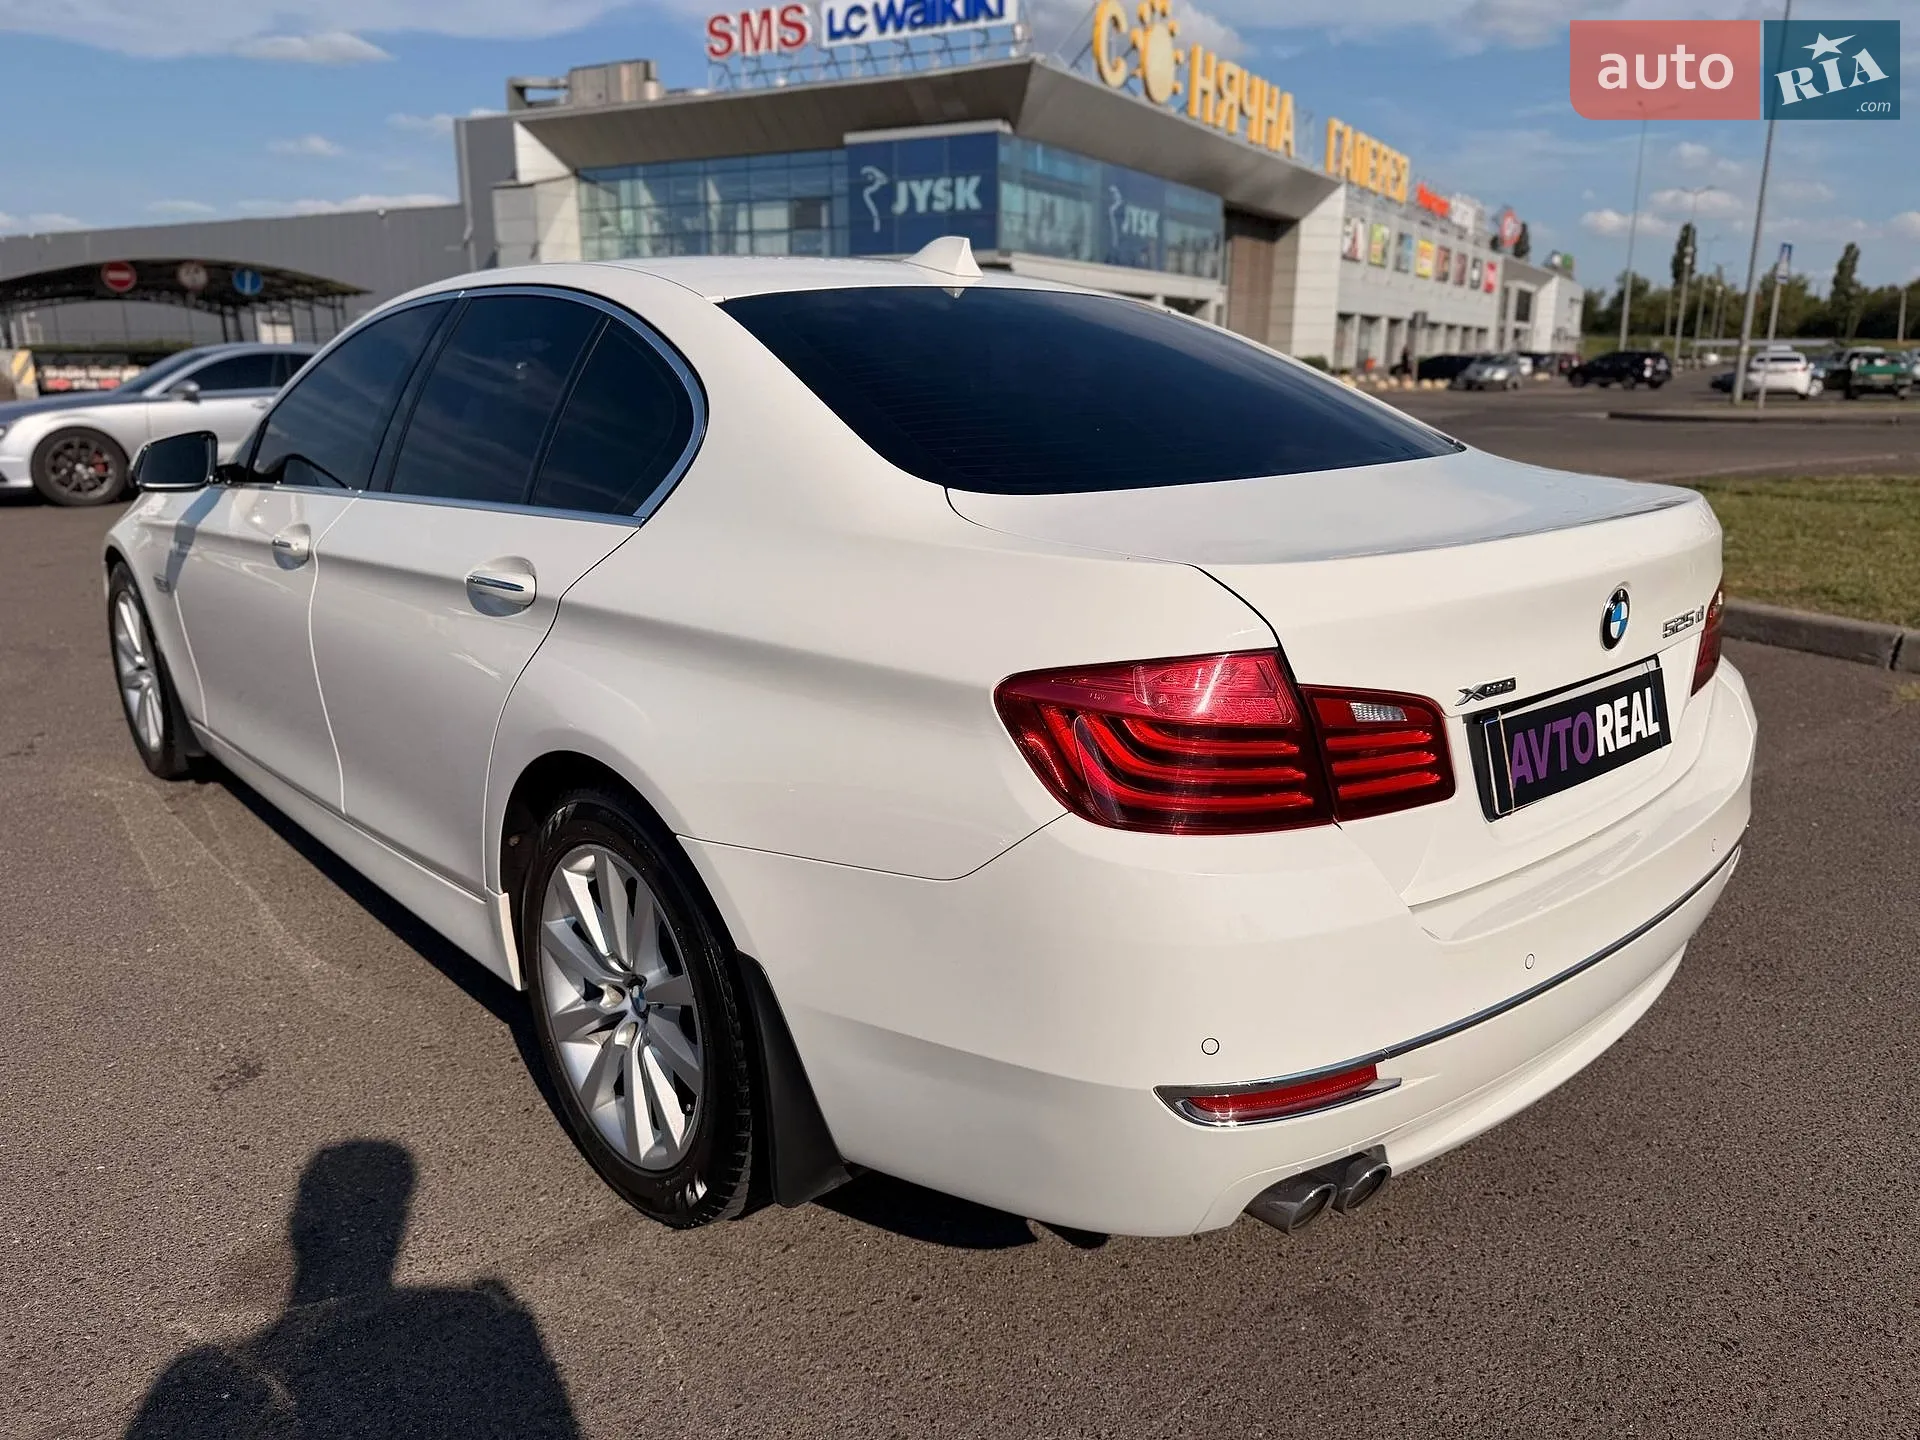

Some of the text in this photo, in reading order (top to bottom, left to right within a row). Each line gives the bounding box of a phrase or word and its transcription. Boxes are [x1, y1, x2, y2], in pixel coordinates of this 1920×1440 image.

[707, 3, 808, 57] SMS
[827, 0, 1005, 41] LC Waikiki
[891, 175, 982, 215] JYSK
[1120, 204, 1160, 238] JYSK
[1511, 686, 1660, 789] AVTOREAL
